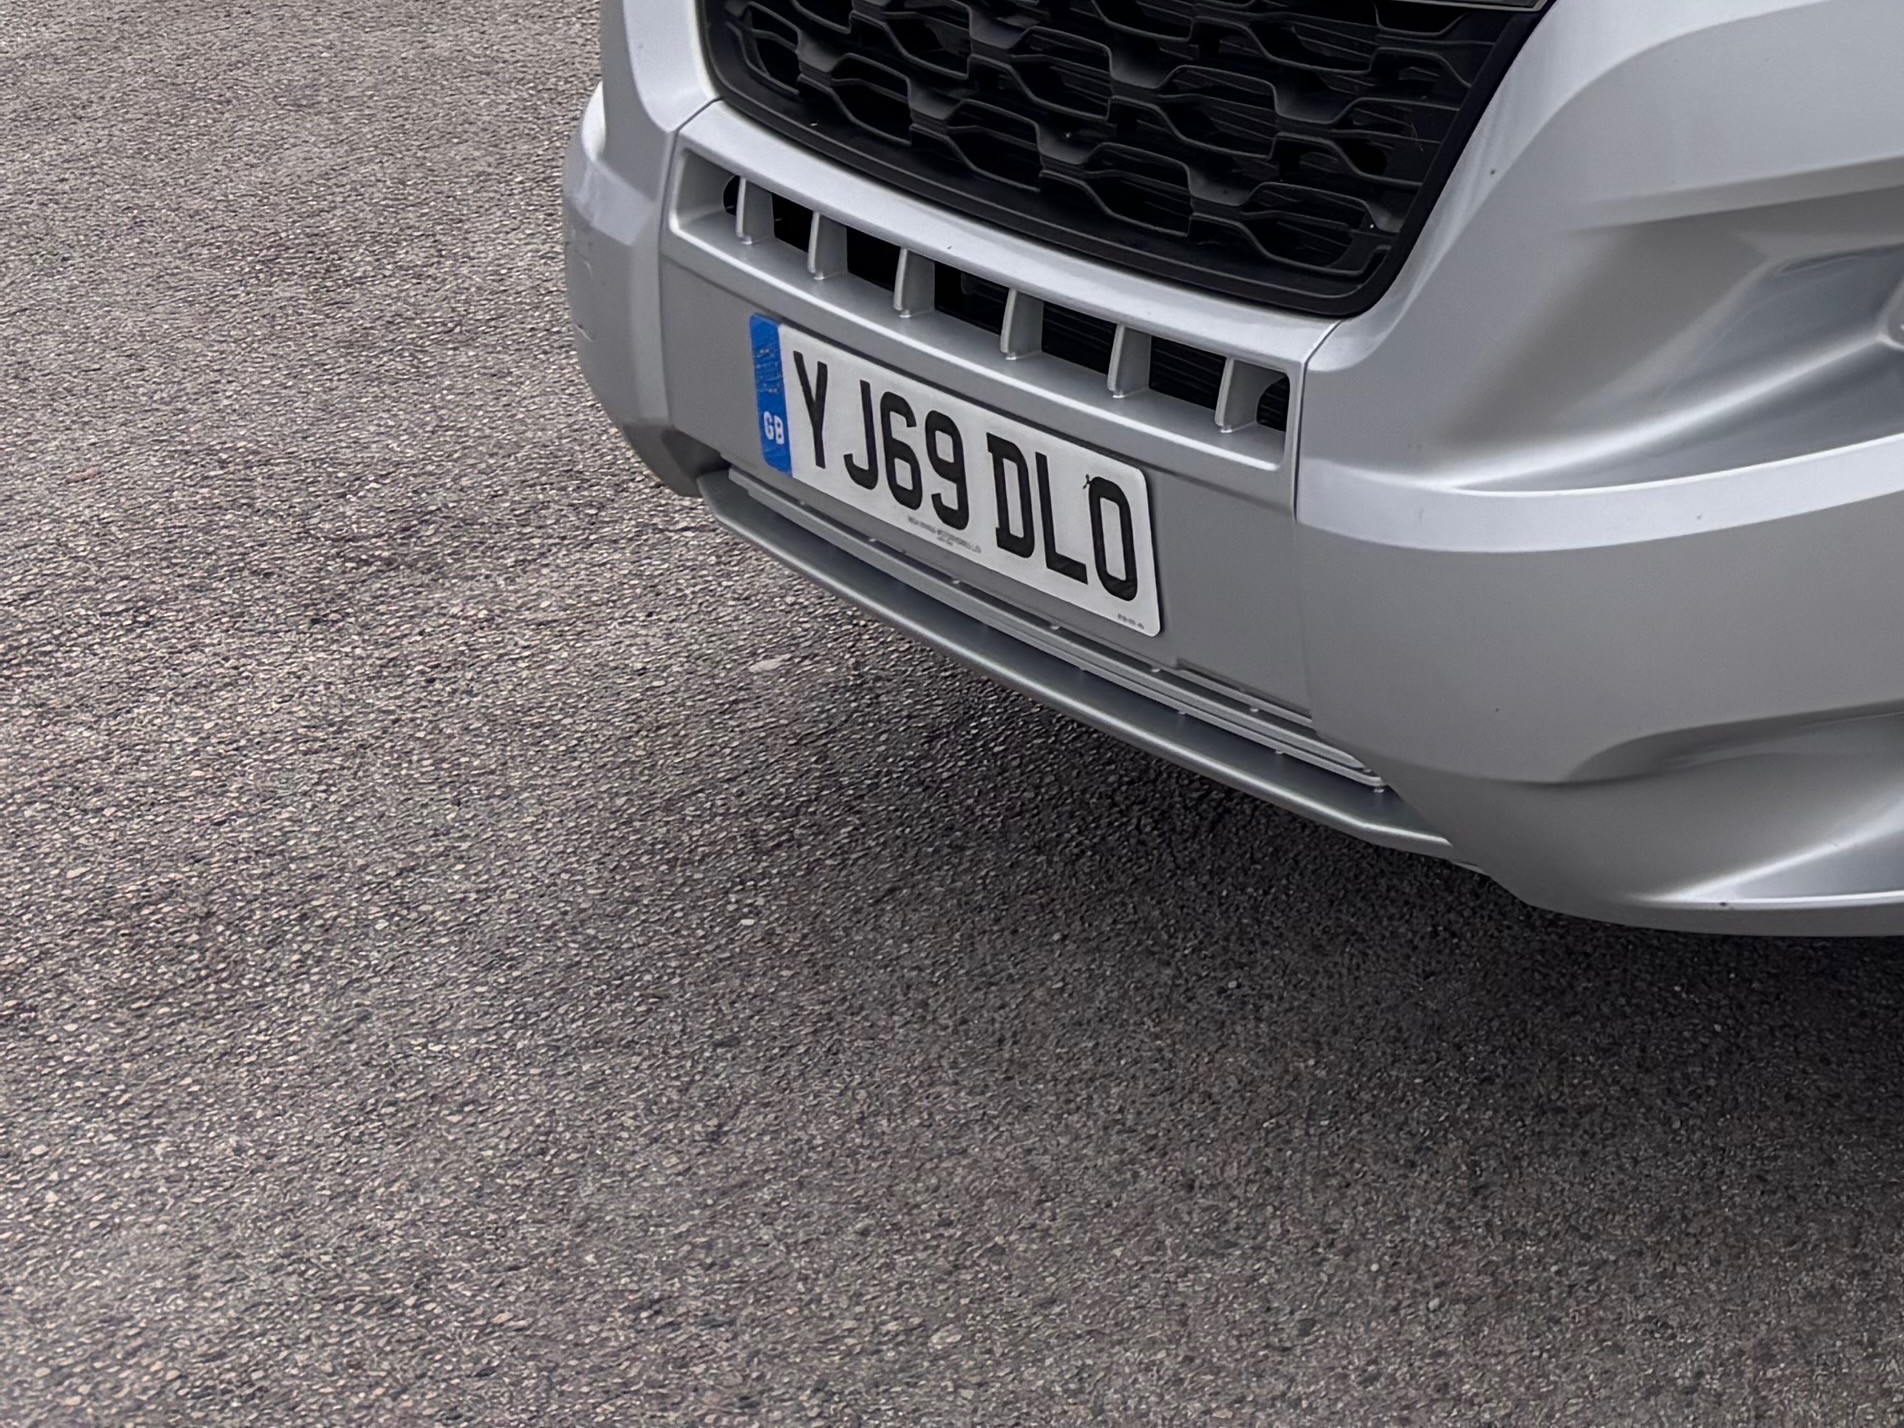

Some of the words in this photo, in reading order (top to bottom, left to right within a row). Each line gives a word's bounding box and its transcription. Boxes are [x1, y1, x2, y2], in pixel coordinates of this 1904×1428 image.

[763, 411, 785, 445] GB
[793, 350, 969, 531] YJ69
[986, 432, 1138, 602] DLO
